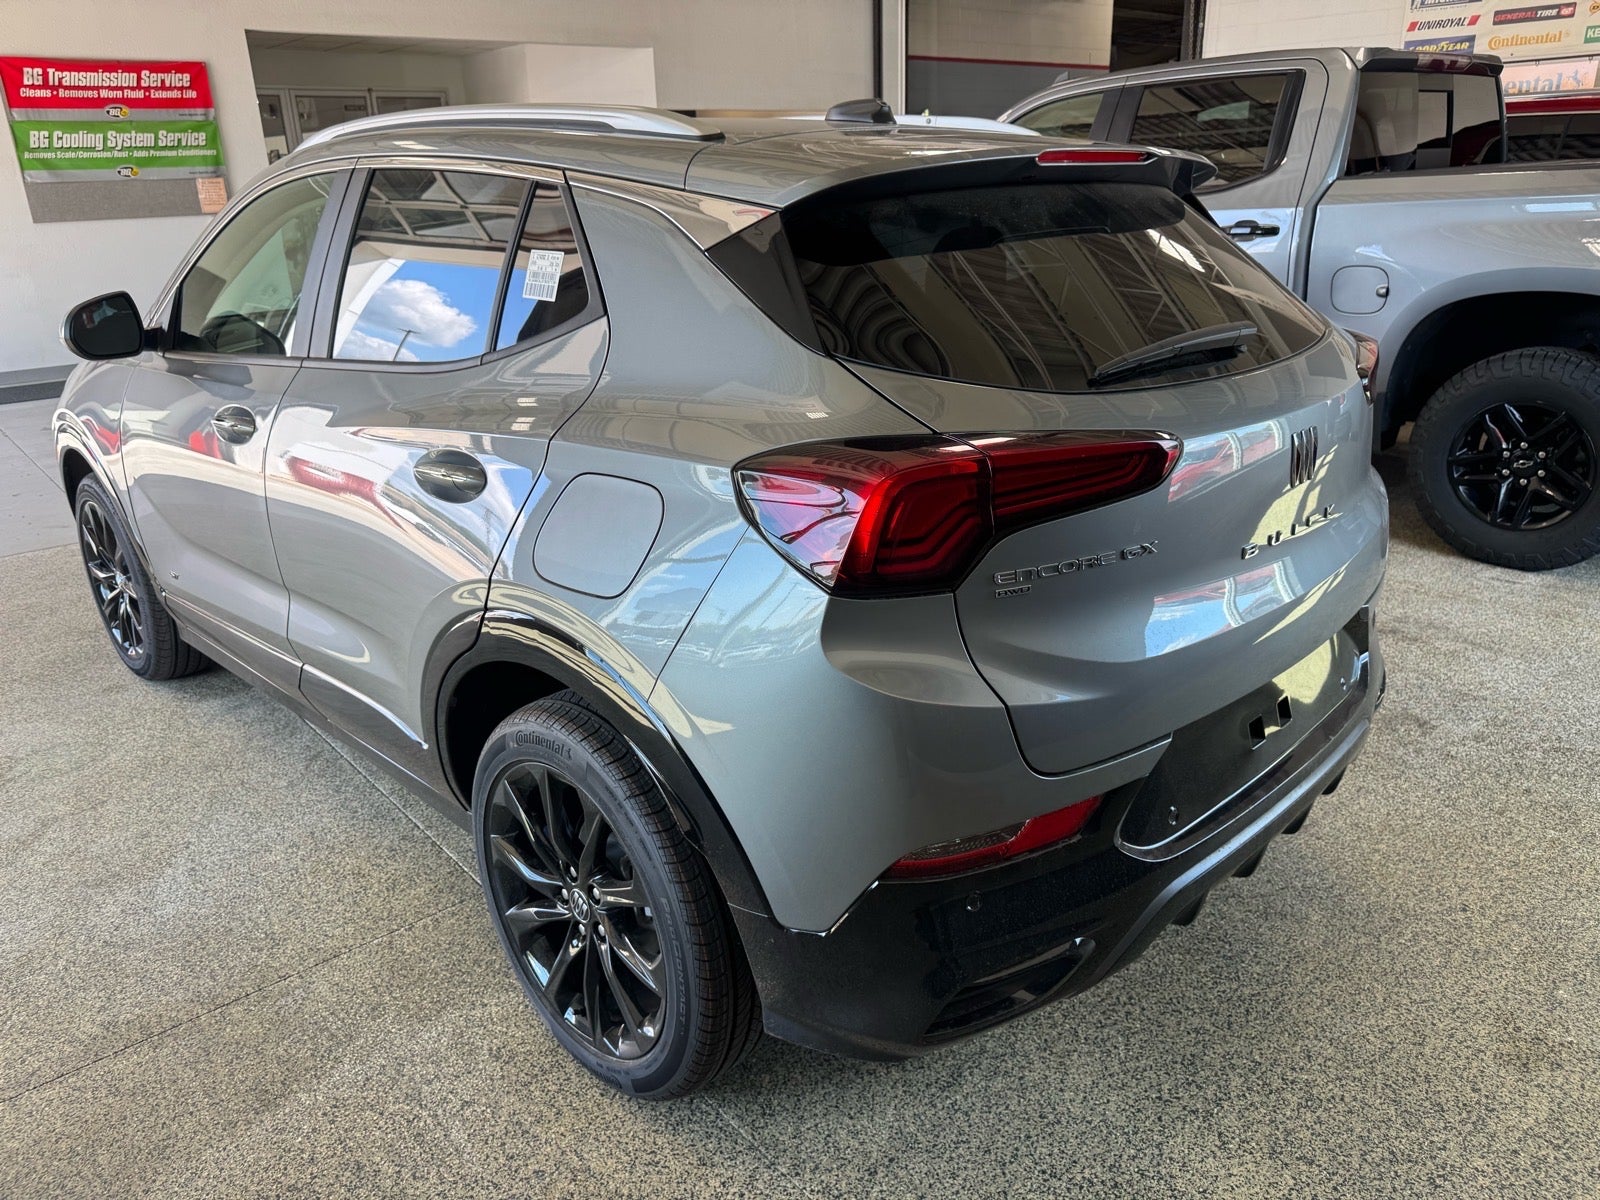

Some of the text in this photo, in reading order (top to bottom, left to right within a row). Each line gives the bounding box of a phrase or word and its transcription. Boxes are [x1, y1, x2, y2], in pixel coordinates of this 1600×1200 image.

[1417, 17, 1468, 31] UNIROYAL
[1494, 9, 1559, 22] GENERAL TIRE
[1488, 30, 1562, 50] Continental
[23, 67, 191, 87] BG Transmission Service
[20, 87, 197, 98] Cleans Removes Worn Fluid Extends Life
[29, 129, 207, 151] BG Cooling System Service
[24, 151, 56, 159] Removes
[1241, 504, 1336, 560] BUICK
[994, 540, 1158, 584] ENCORE GX
[516, 730, 565, 757] Continental
